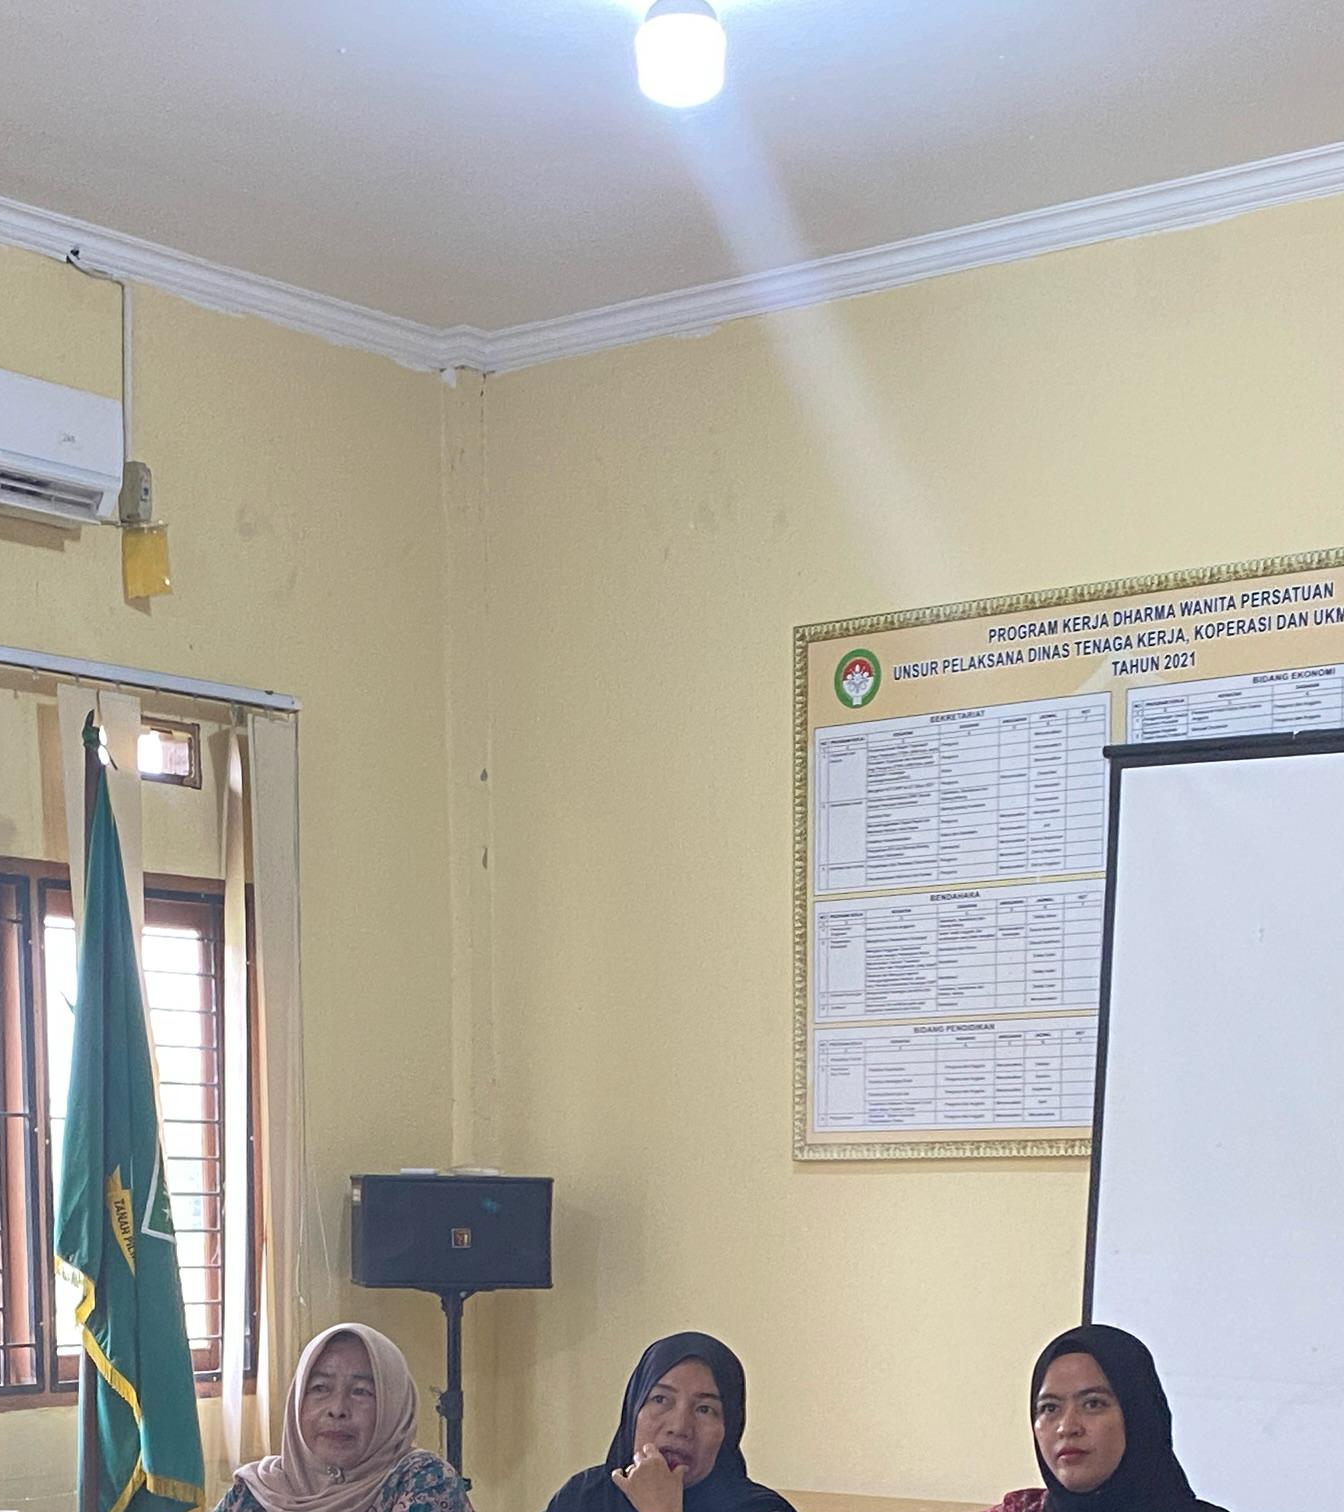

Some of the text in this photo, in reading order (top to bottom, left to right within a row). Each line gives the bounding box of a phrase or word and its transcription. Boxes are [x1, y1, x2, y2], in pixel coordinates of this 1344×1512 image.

[989, 582, 1335, 643] PROGRAM KERJA DHARMA WANITA PERSATUAN
[894, 660, 939, 681] UNSUR
[942, 649, 1024, 674] PELAKSANA
[1028, 642, 1071, 663] DINAS
[1075, 634, 1133, 657] TENAGA
[1137, 628, 1190, 649] KERJA,
[1194, 616, 1272, 641] KOPERASI
[1277, 611, 1309, 631] DAN
[1112, 651, 1197, 677] TAHUN 2021
[1252, 667, 1336, 684] BIDANG EKONOMI
[929, 709, 986, 724] SEKRETARIAT
[929, 890, 980, 902] BENDAHARA
